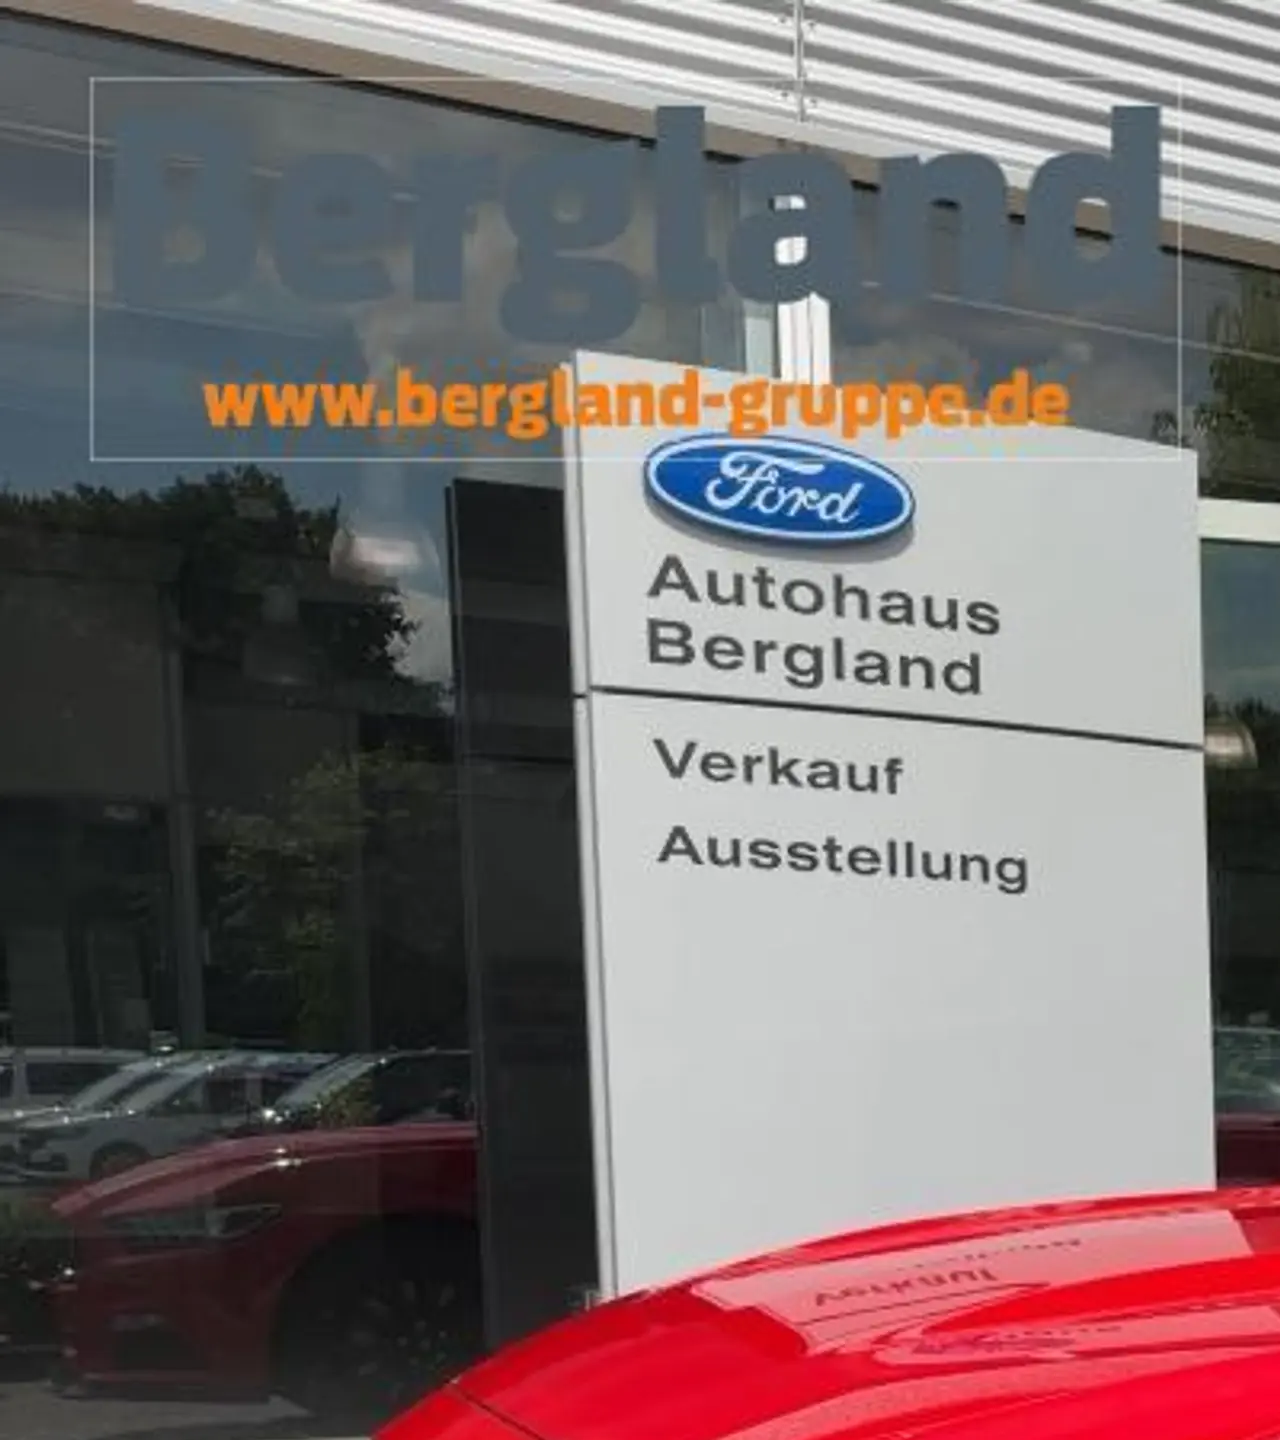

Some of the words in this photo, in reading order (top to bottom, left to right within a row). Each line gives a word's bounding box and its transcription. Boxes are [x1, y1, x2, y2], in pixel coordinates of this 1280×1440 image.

[704, 450, 865, 524] Ford
[647, 554, 1001, 636] Autohaus
[646, 617, 983, 696] Bergland
[653, 738, 904, 795] Verkauf
[657, 825, 1029, 895] Ausstellung
